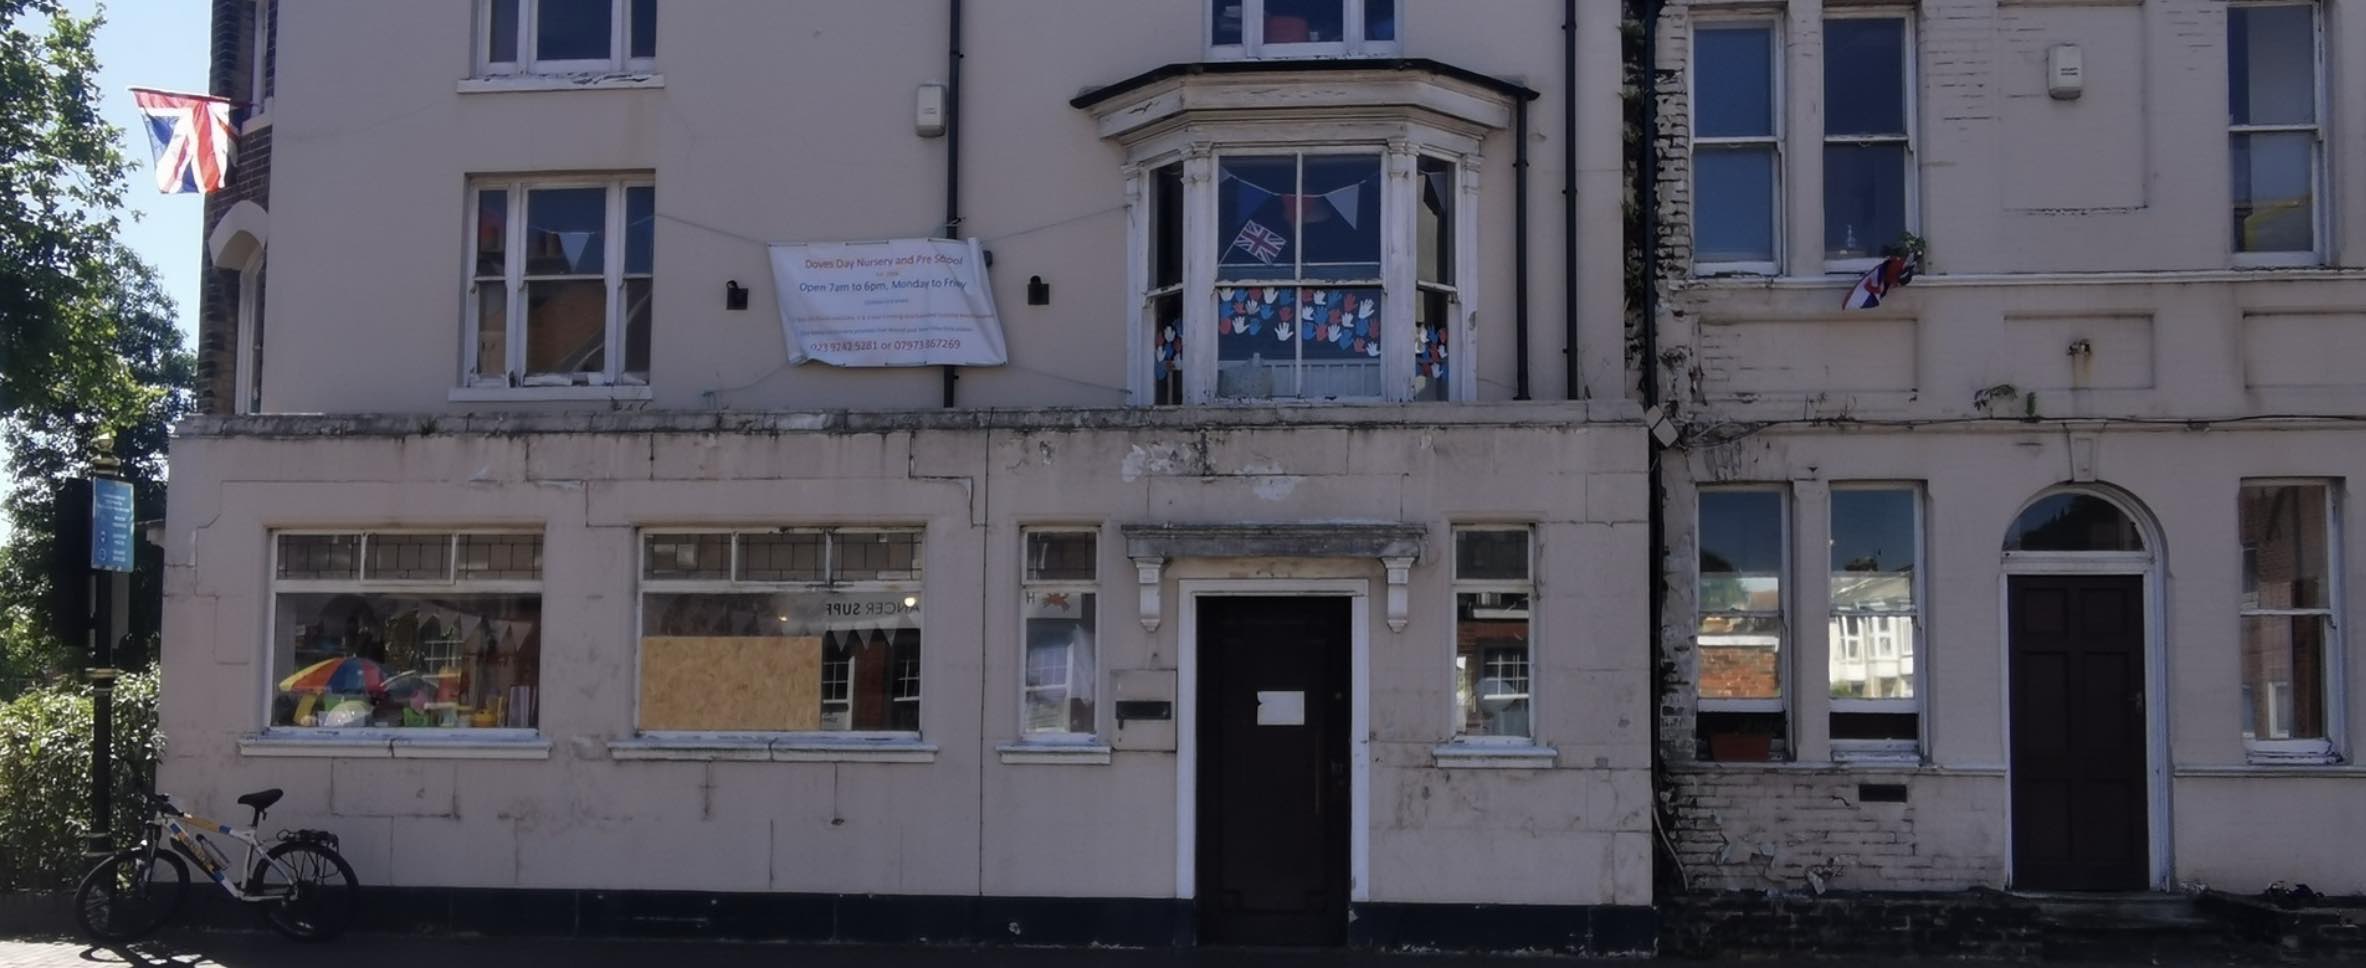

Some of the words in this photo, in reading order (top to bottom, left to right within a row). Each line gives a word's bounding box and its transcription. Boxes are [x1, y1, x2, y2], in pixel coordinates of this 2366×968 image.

[805, 258, 834, 270] Doves
[836, 257, 854, 271] Day
[856, 256, 893, 268] Nursery
[895, 254, 914, 265] and
[916, 254, 932, 264] Pre
[799, 281, 826, 293] Open
[828, 281, 849, 292] 7am
[852, 282, 862, 292] to
[891, 278, 929, 290] Monday
[931, 278, 941, 288] to
[943, 277, 967, 291] Friy
[880, 341, 891, 351] or
